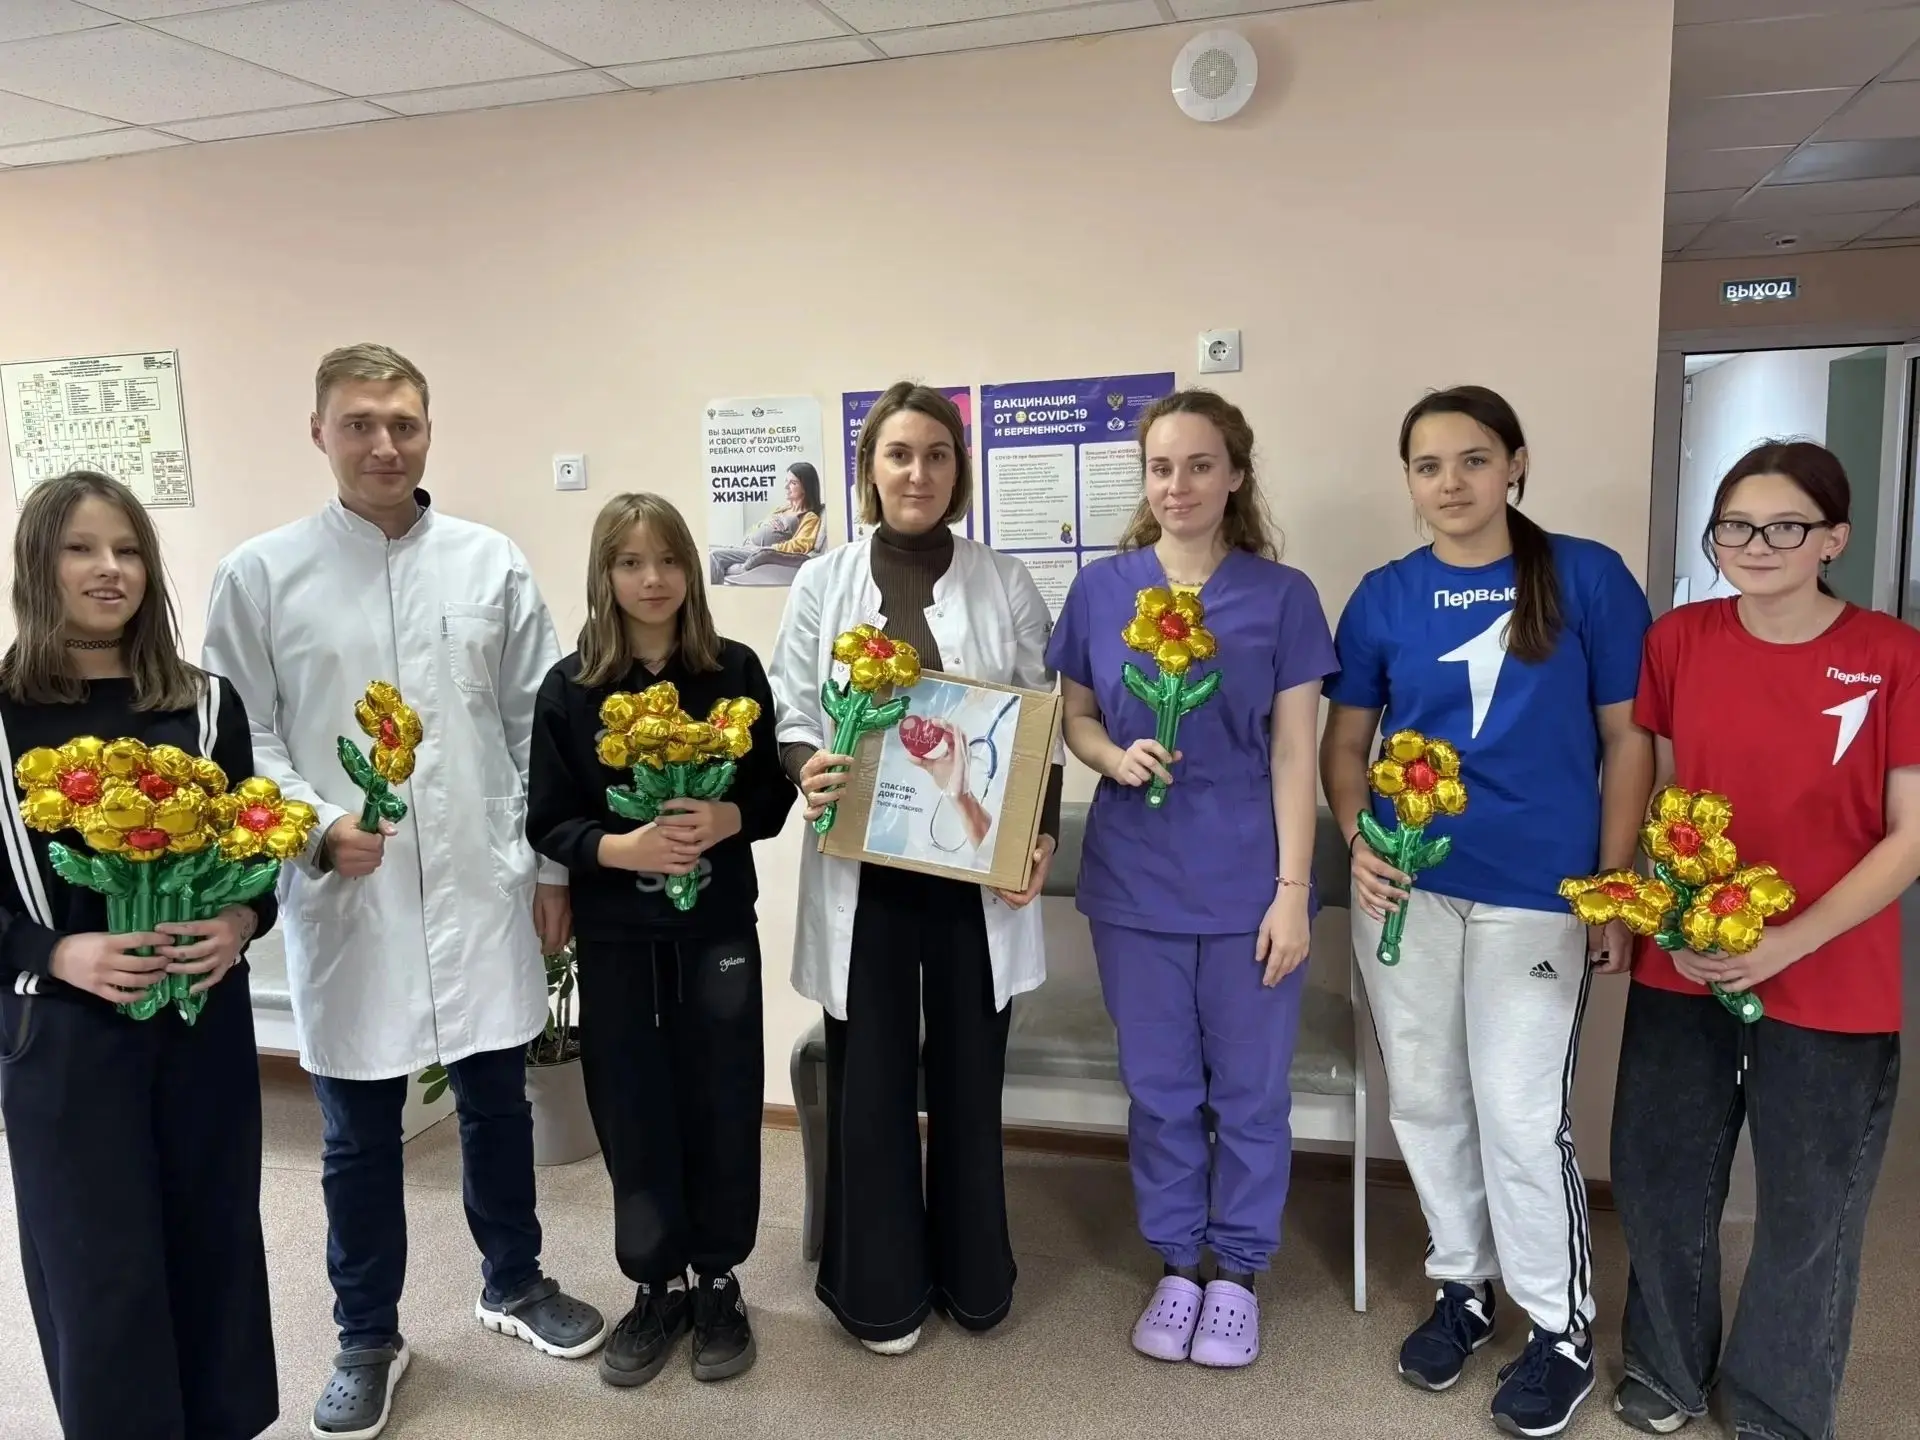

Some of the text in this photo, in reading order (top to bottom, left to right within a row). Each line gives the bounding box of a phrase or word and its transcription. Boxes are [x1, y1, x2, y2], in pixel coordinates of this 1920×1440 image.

[1726, 281, 1792, 298] ВЫХОД
[994, 394, 1076, 409] ВАКЦИНАЦИЯ
[994, 408, 1088, 424] ОТ COVID-19
[721, 427, 766, 436] ЗАЩИТИЛИ
[776, 426, 797, 434] СЕБЯ
[994, 423, 1086, 437] И БЕРЕМЕННОСТЬ
[757, 435, 801, 444] БУДУЩЕГО
[709, 446, 745, 455] РЕБЁНКА
[746, 446, 757, 454] ОТ
[711, 464, 776, 474] ВАКЦИНАЦИЯ
[712, 476, 776, 488] СПАСАЕТ
[712, 490, 768, 503] ЖИЗНИ!
[1826, 666, 1882, 685] Первые
[880, 782, 918, 795] СПАСИБО,
[878, 790, 912, 801] ДОКТОР!
[1529, 970, 1558, 980] adidas
